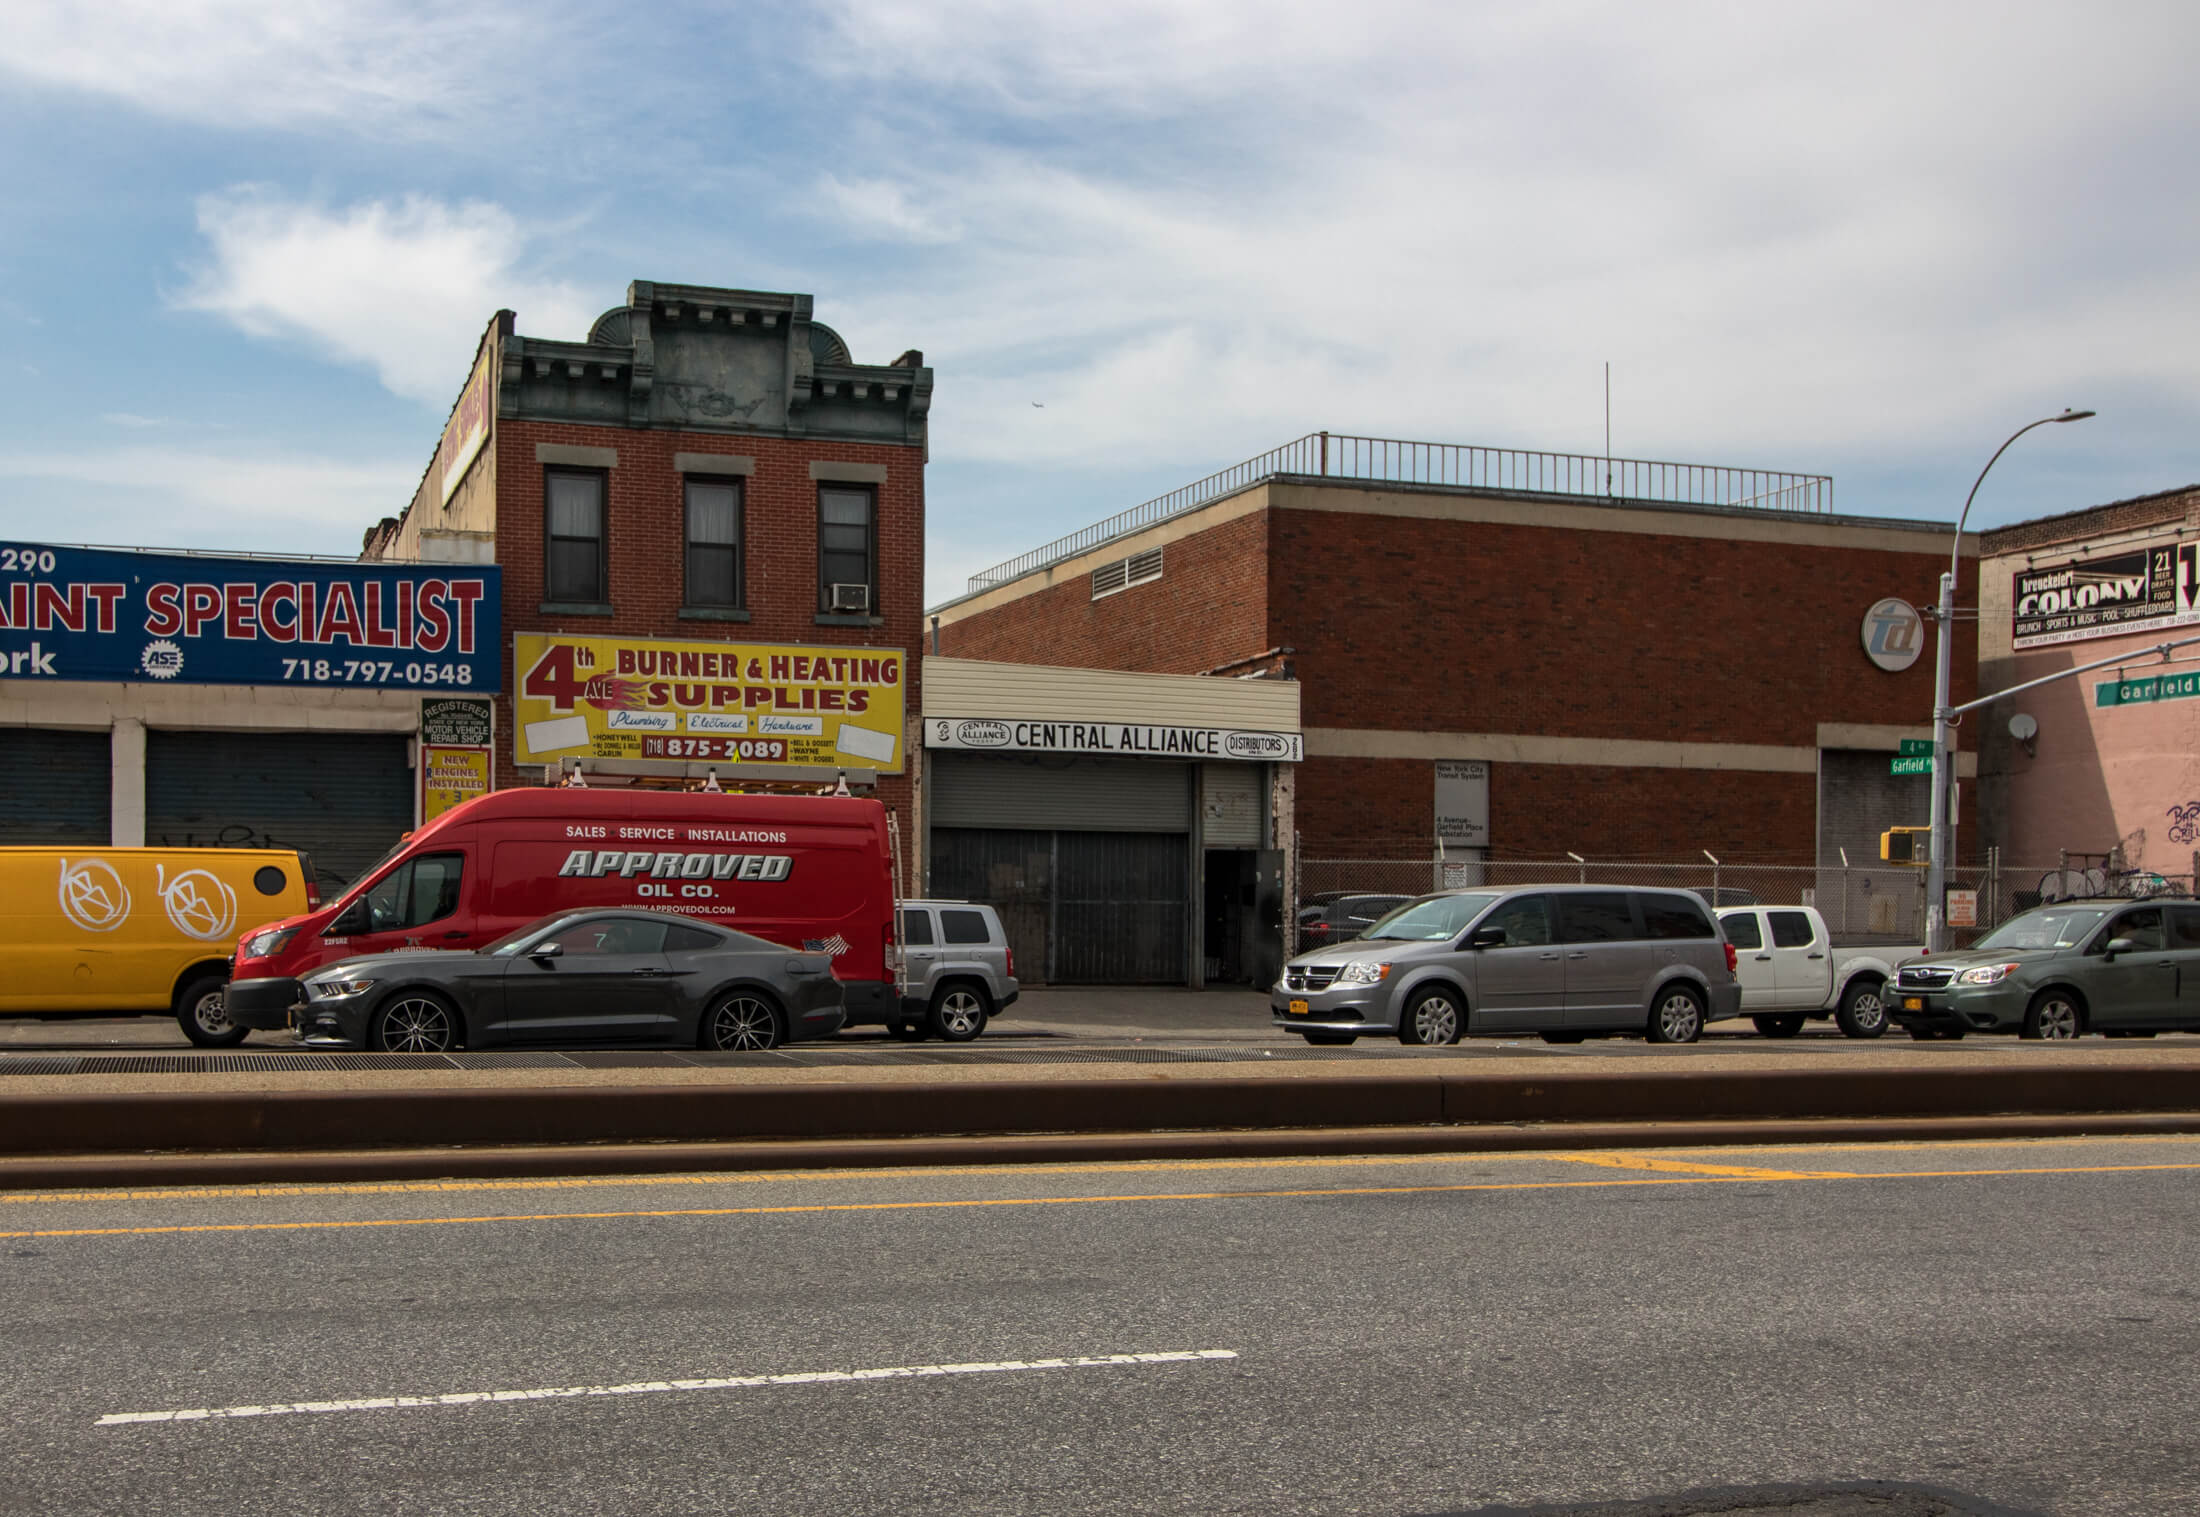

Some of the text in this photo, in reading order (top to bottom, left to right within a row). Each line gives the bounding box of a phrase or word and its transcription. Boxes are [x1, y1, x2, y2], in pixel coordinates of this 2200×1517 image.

[0, 549, 56, 574] 290
[2155, 551, 2172, 572] 21
[2154, 571, 2171, 580] BEER
[2151, 579, 2174, 589] DRAFTS
[2018, 576, 2146, 617] COLONY
[2154, 591, 2171, 601] FOOD
[143, 577, 484, 655] SPECIALIST
[2016, 601, 2175, 635] BRUNCH SPORTS & MUSIC POOL SHUFFLEBOARD
[2048, 634, 2065, 643] PARTY
[148, 651, 178, 666] ASE
[281, 658, 473, 686] 718-797-0548
[615, 649, 899, 688] BURNER & HEATING
[583, 681, 614, 700] AVE
[2120, 678, 2193, 700] Garfield
[646, 681, 870, 716] SUPPLIES
[424, 701, 489, 719] REGISTERED
[611, 711, 814, 732] Plumbing Electrical Hardware
[962, 721, 1004, 731] CENTRAL
[424, 725, 489, 735] MOTOR VEHICLE
[961, 731, 1006, 740] ALLIANCE
[431, 734, 484, 744] REPAIR SHOP
[597, 734, 638, 742] HONEYWELL
[1015, 723, 1220, 754] CENTRAL ALLIANCE
[1229, 736, 1282, 751] DISTRIBUTORS
[597, 750, 622, 758] CARLIN
[646, 737, 783, 759] (718) 875-2089
[793, 747, 819, 755] WAYNE
[1909, 741, 1915, 753] 4
[442, 756, 471, 767] NEW
[1892, 759, 1925, 773] Garfield
[433, 767, 480, 779] ENGINES
[1460, 772, 1485, 780] System
[1470, 765, 1484, 773] City
[427, 779, 485, 791] INSTALLED
[1466, 823, 1484, 831] Place
[566, 826, 787, 843] SALES SERVICE INSTALLATIONS
[558, 850, 795, 882] APPROVED
[637, 884, 720, 898] OIL CO.
